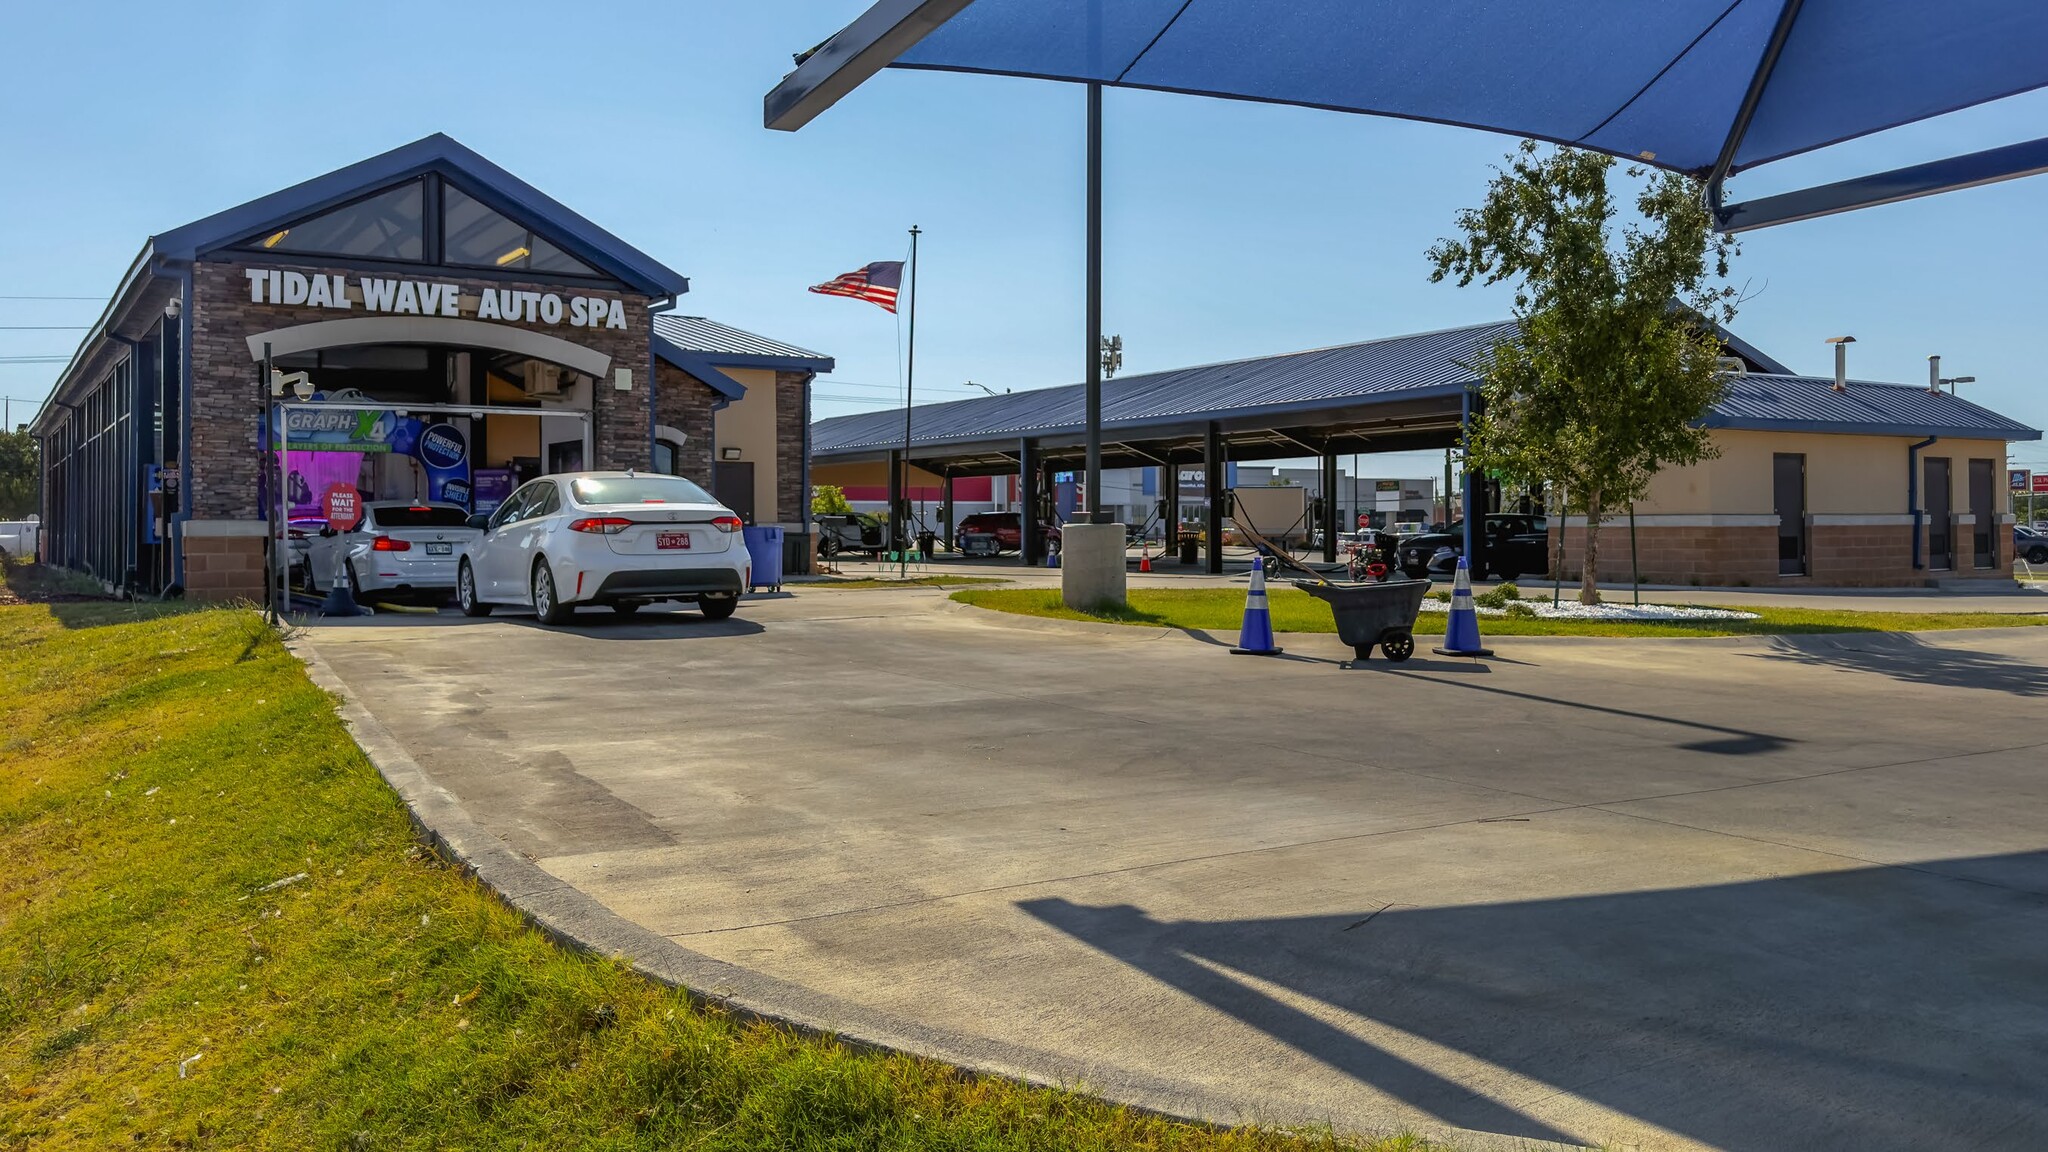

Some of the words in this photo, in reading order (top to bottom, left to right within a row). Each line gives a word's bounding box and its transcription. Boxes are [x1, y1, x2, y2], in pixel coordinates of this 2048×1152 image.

[245, 268, 351, 309] TIDAL
[360, 277, 459, 317] WAVE
[478, 288, 563, 325] AUTO
[570, 296, 628, 330] SPA
[288, 443, 319, 451] LAYERS
[323, 443, 333, 451] OF
[335, 443, 387, 452] PROTECTION
[427, 431, 463, 454] POWERFUL
[424, 440, 461, 461] PROTECTION
[331, 498, 355, 507] WAIT
[444, 489, 469, 503] SHIELD
[658, 537, 671, 546] SYD
[676, 537, 689, 546] 288
